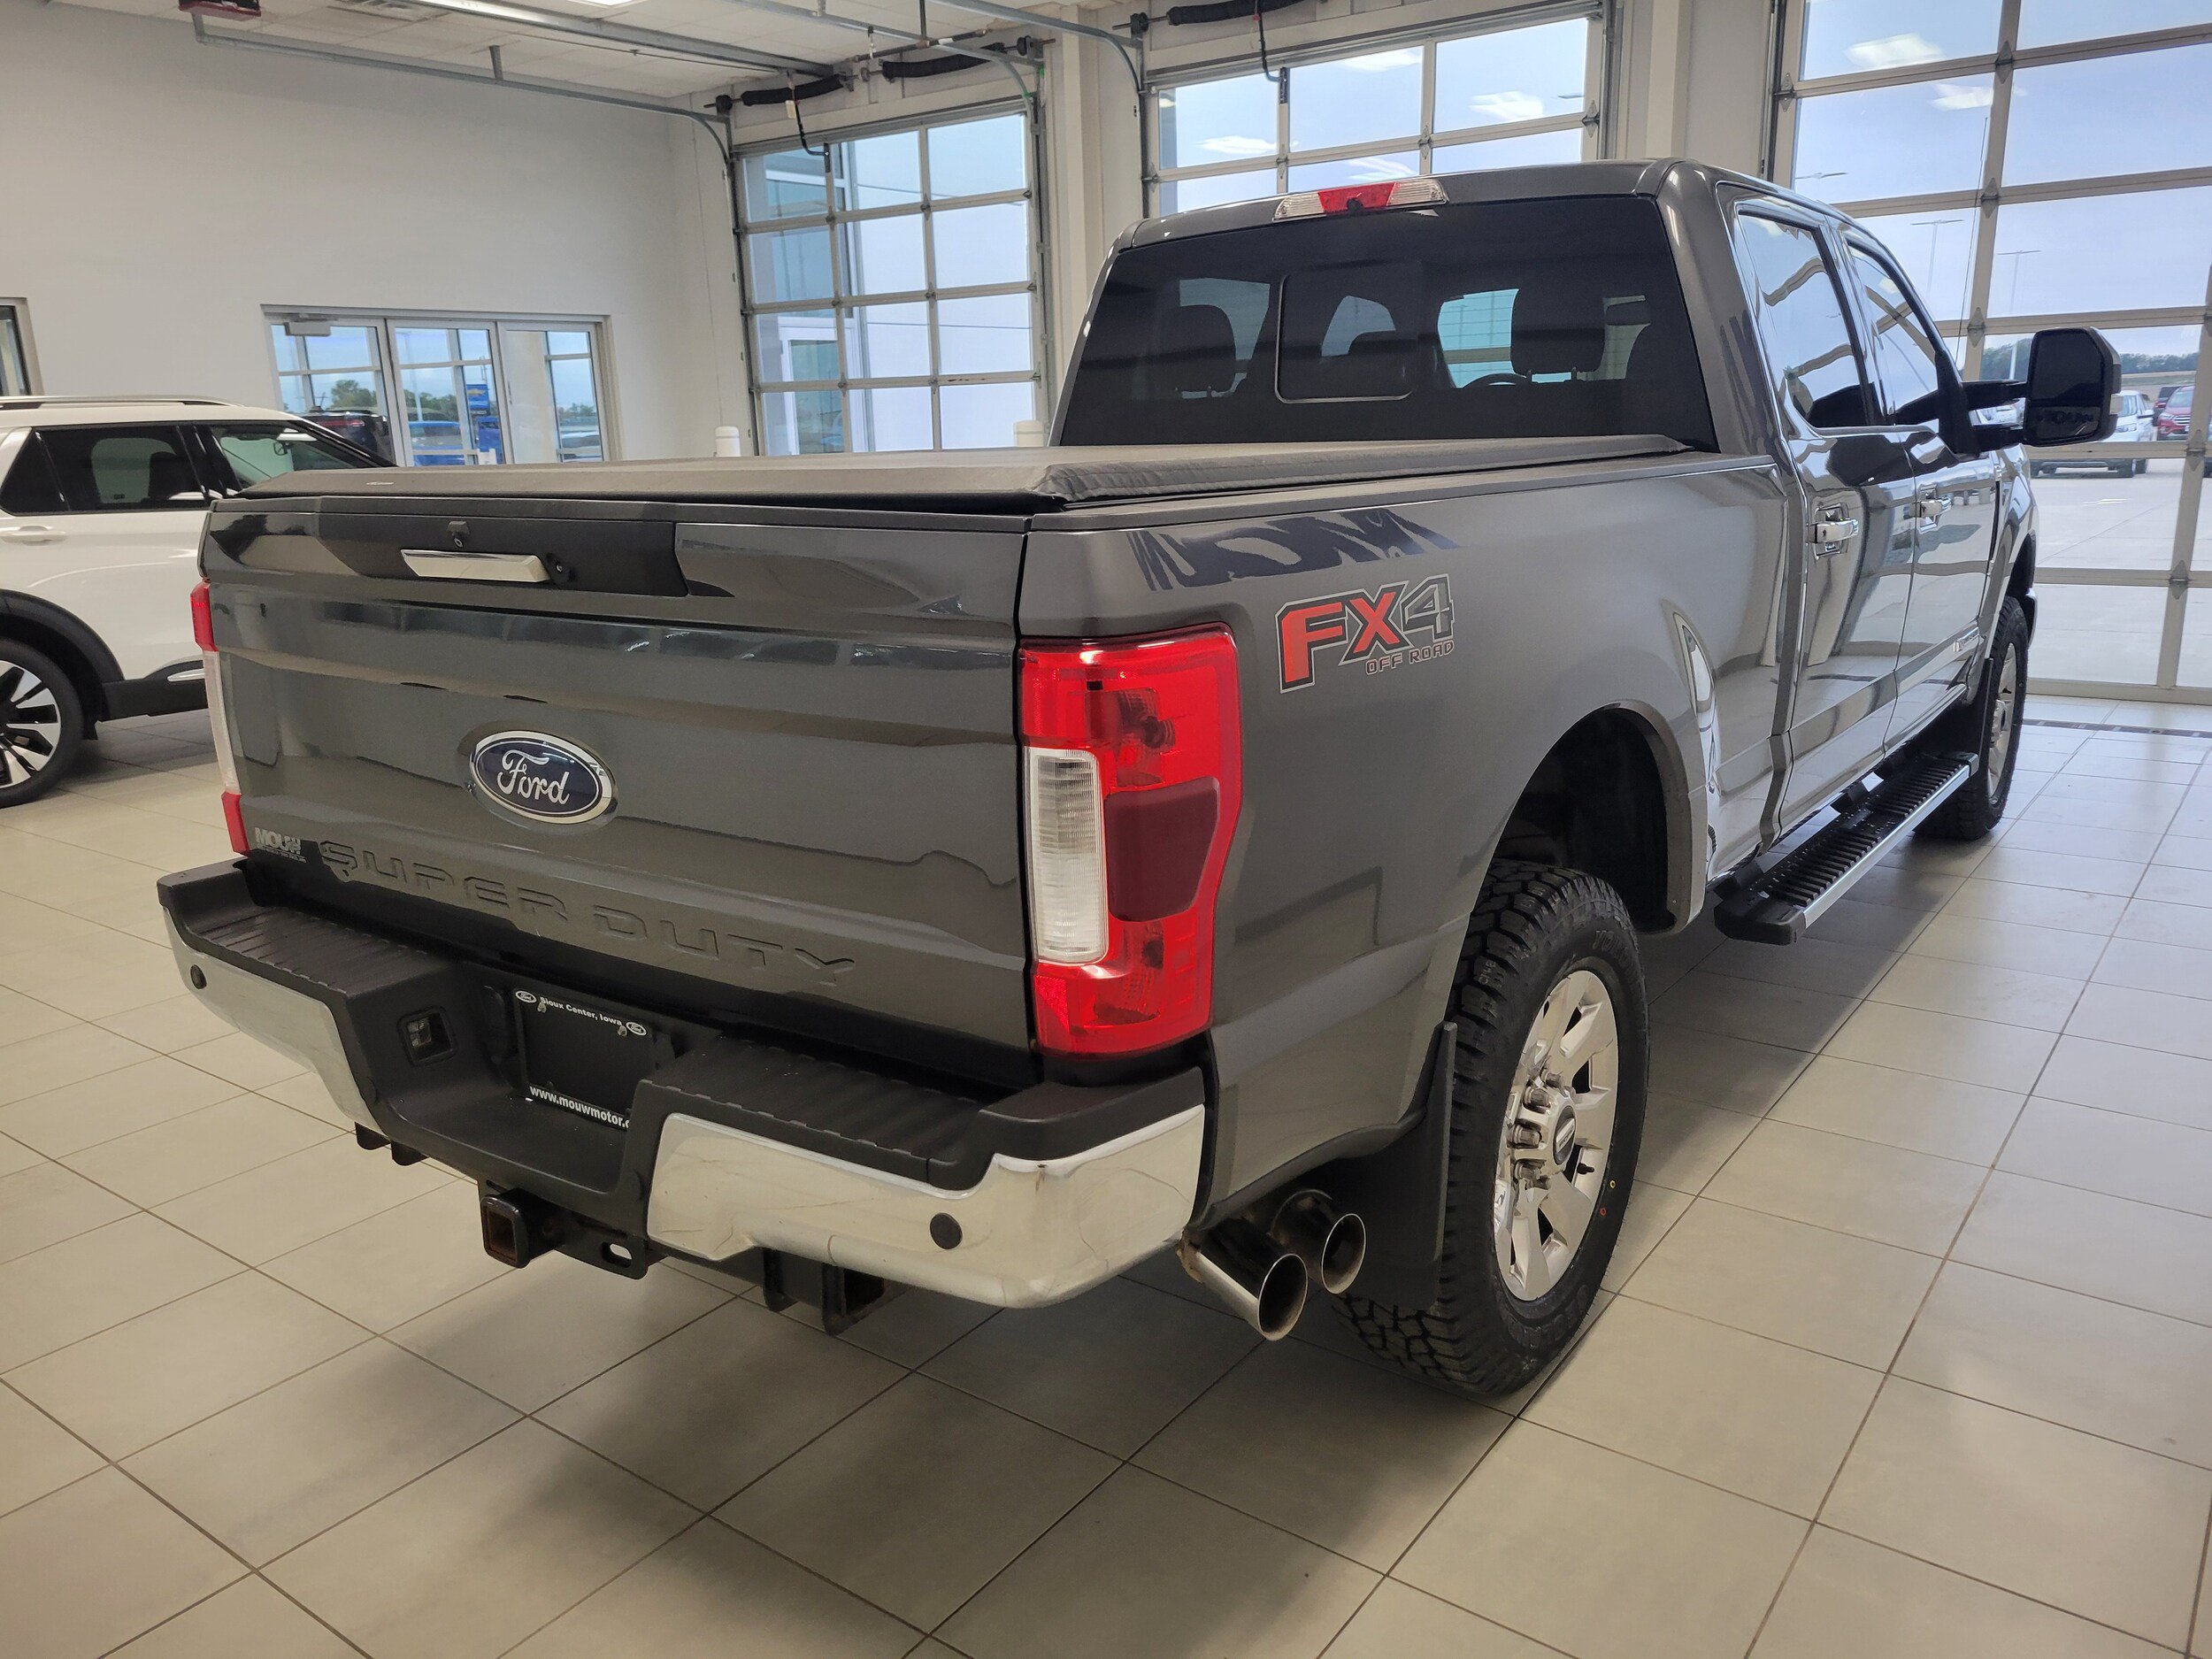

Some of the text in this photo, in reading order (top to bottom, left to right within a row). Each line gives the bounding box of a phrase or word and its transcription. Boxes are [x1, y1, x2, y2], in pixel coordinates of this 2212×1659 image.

[1275, 573, 1455, 694] FX4
[1365, 640, 1455, 675] OFF ROAD
[497, 749, 571, 804] Ford
[320, 840, 856, 987] SUPER DUTY
[540, 997, 623, 1026] Sioux Center, Iowa
